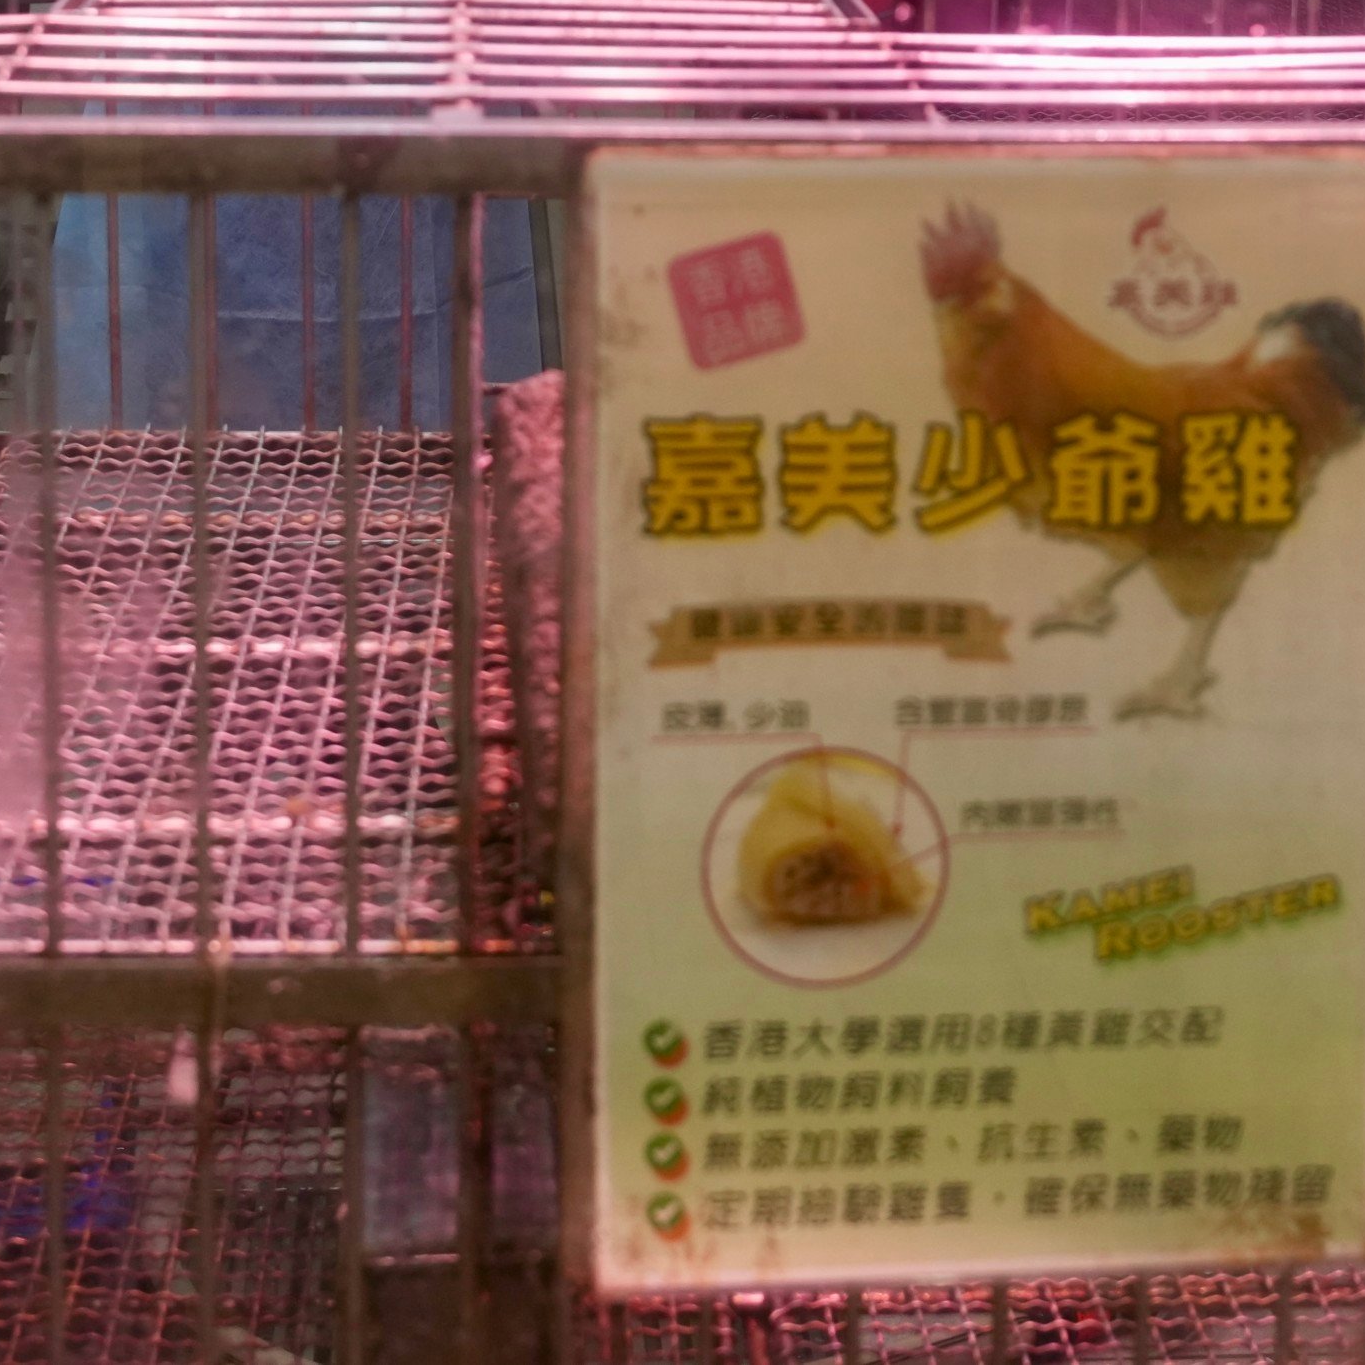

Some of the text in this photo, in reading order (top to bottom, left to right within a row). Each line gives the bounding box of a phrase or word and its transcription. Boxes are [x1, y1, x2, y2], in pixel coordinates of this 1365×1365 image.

[640, 409, 1301, 538] 嘉美少爺雞
[1023, 863, 1196, 936] KAMEI
[1093, 872, 1342, 965] ROOSTER
